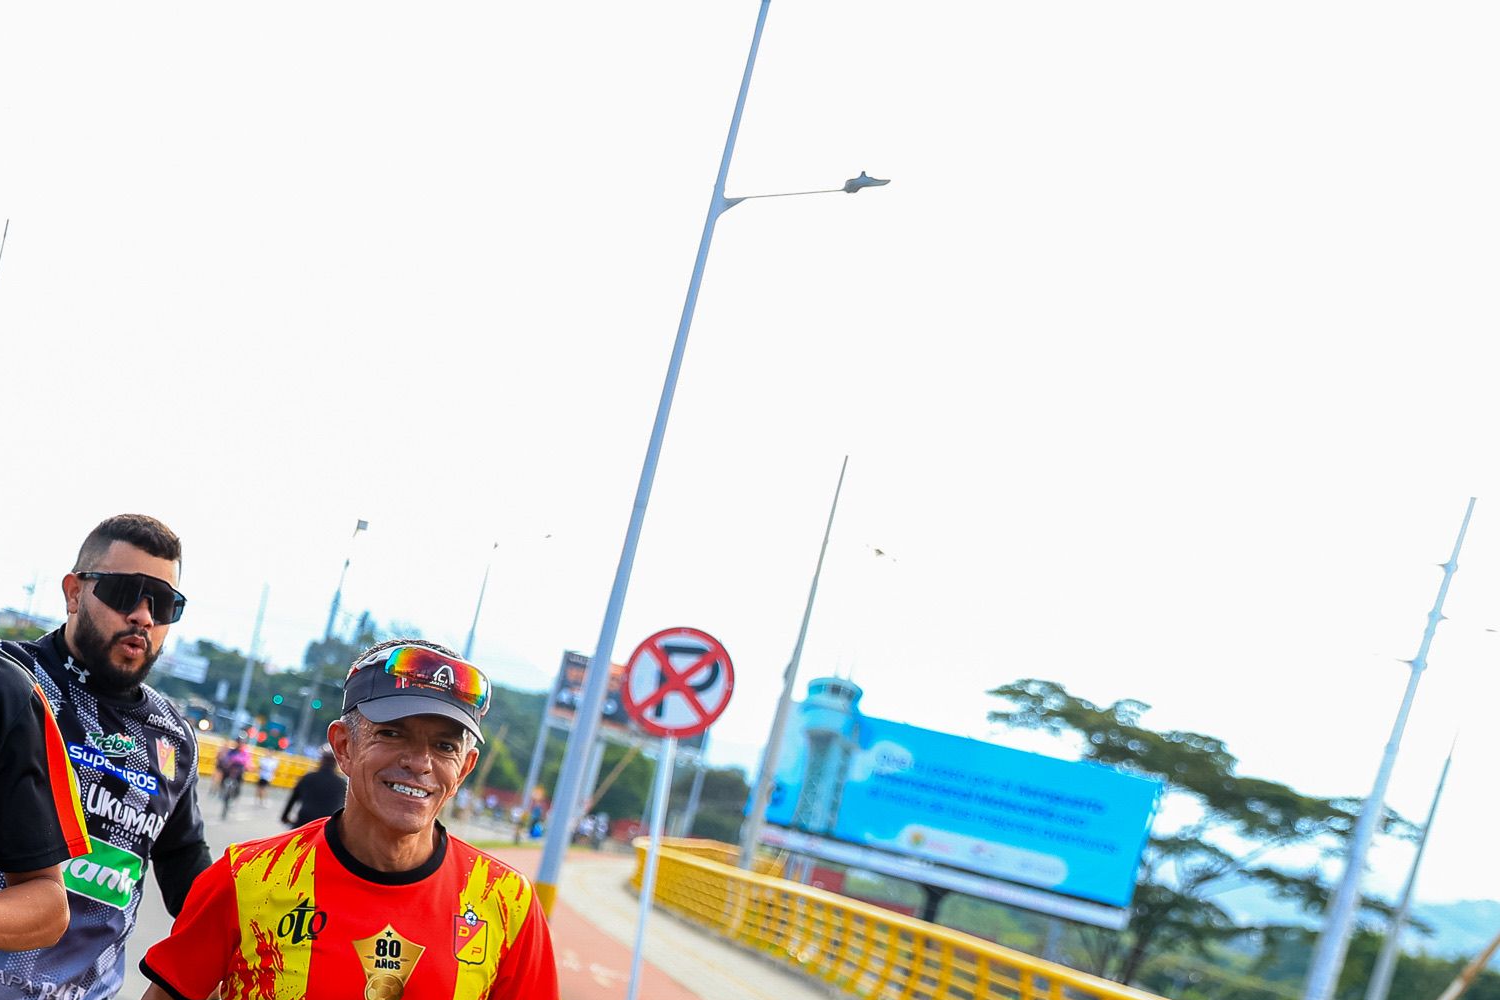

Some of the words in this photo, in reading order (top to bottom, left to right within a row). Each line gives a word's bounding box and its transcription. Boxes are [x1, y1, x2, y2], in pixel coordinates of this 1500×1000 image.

[61, 858, 138, 896] ant
[458, 926, 471, 938] D
[375, 938, 401, 959] 80
[471, 947, 482, 956] P
[374, 958, 401, 970] AÑOS
